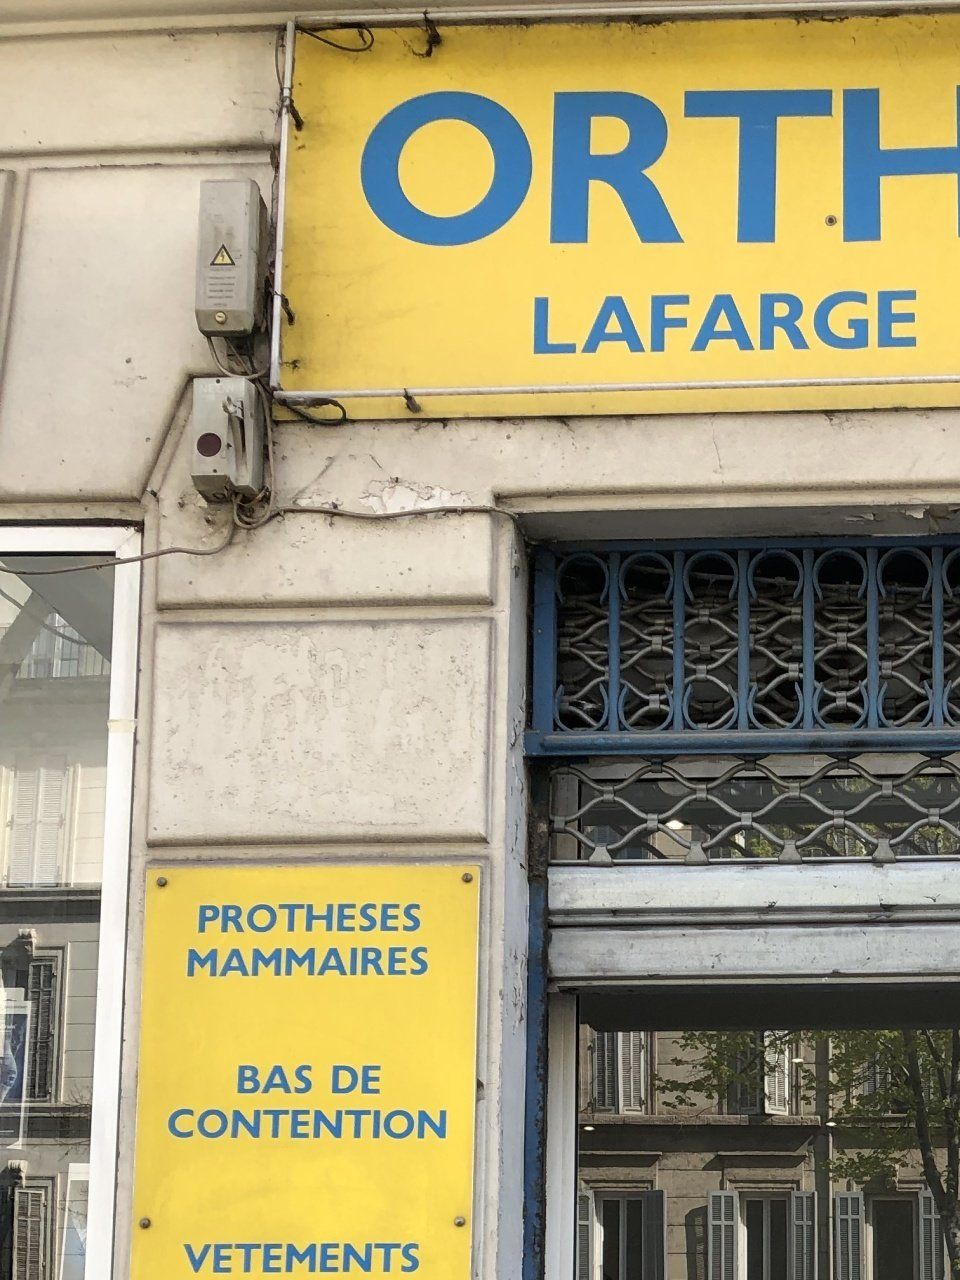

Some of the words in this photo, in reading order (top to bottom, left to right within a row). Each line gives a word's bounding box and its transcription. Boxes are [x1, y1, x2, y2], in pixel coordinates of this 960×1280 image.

[535, 291, 915, 353] LAFARGE
[197, 903, 421, 934] PROTHESES
[186, 946, 429, 977] MAMMAIRES
[237, 1065, 313, 1094] BAS
[331, 1065, 381, 1094] DE
[168, 1109, 447, 1139] CONTENTION
[184, 1243, 420, 1273] VETEMENTS
